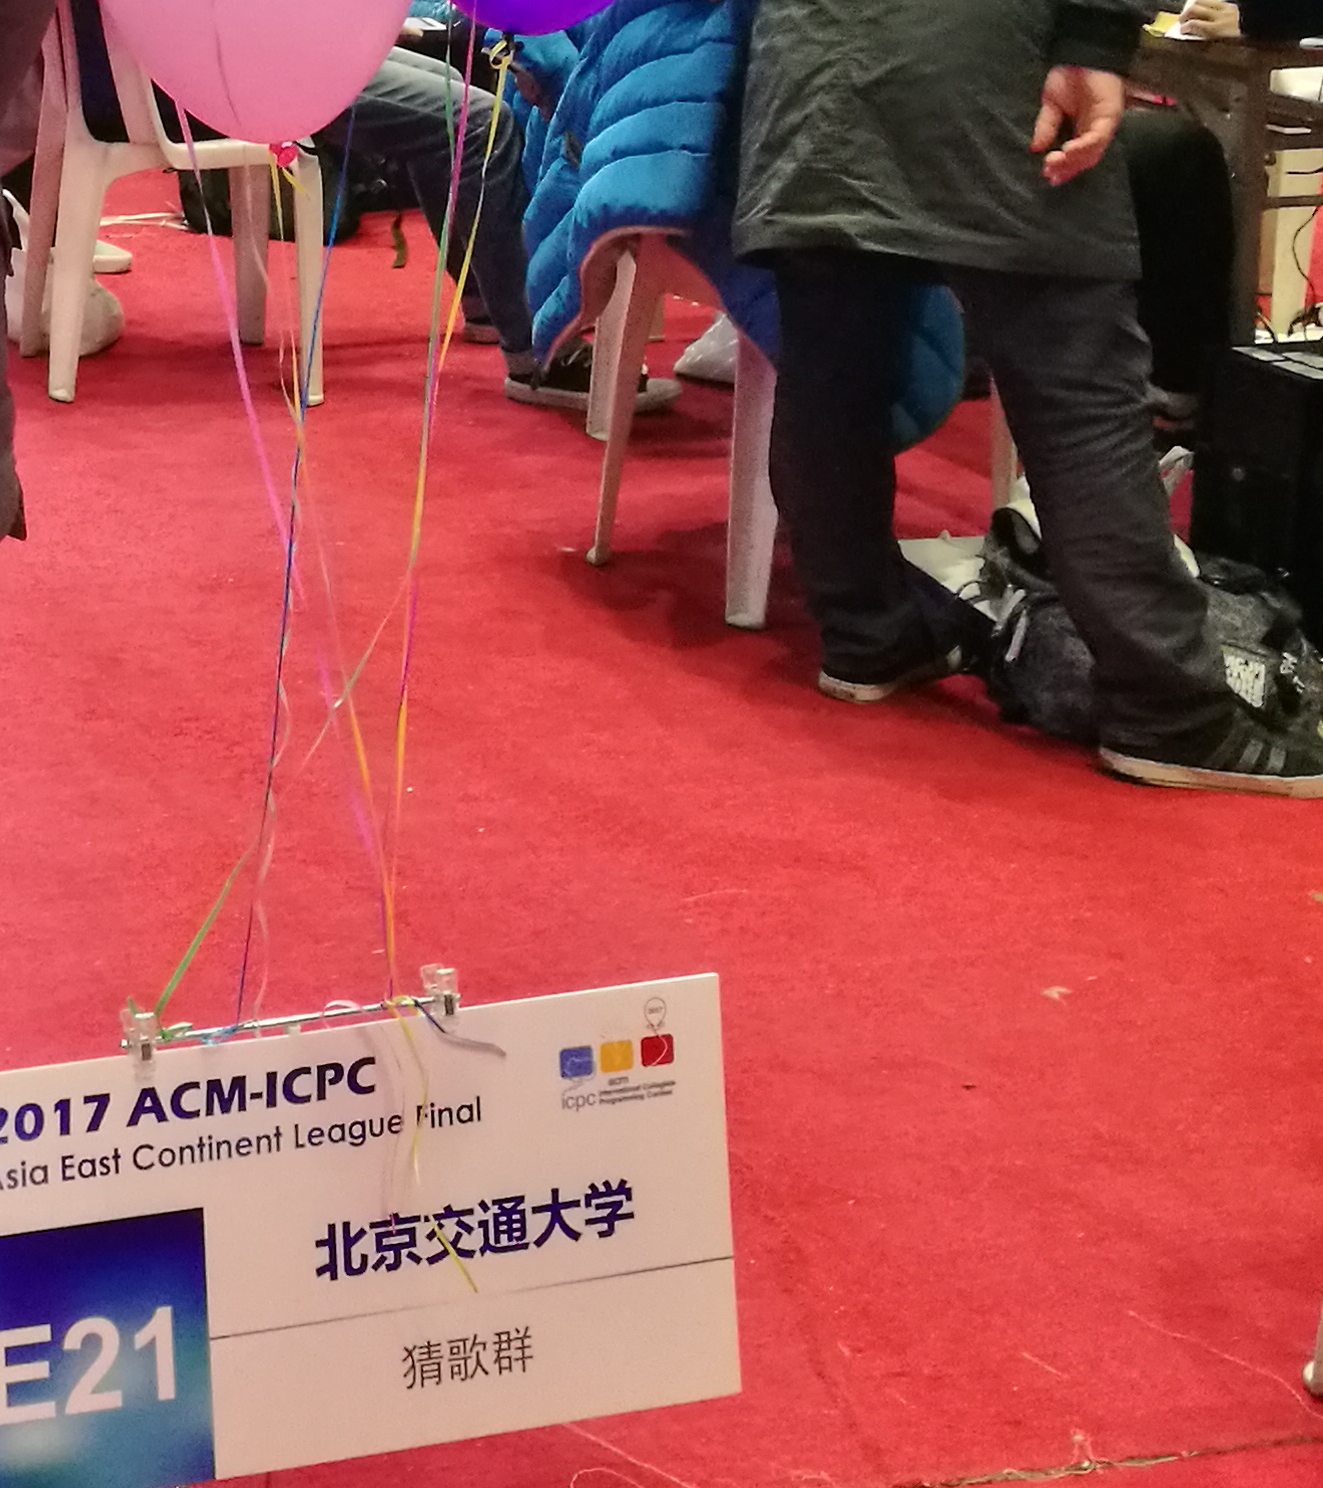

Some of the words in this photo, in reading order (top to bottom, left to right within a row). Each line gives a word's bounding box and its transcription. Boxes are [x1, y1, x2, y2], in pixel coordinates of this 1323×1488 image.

[126, 1056, 376, 1128] ACM-ICPC
[561, 1092, 597, 1113] icpc
[61, 1147, 122, 1182] East
[132, 1125, 283, 1171] Continent
[295, 1113, 403, 1149] League
[314, 1178, 636, 1282] 北京交通大学
[401, 1325, 534, 1390] 猜歌群
